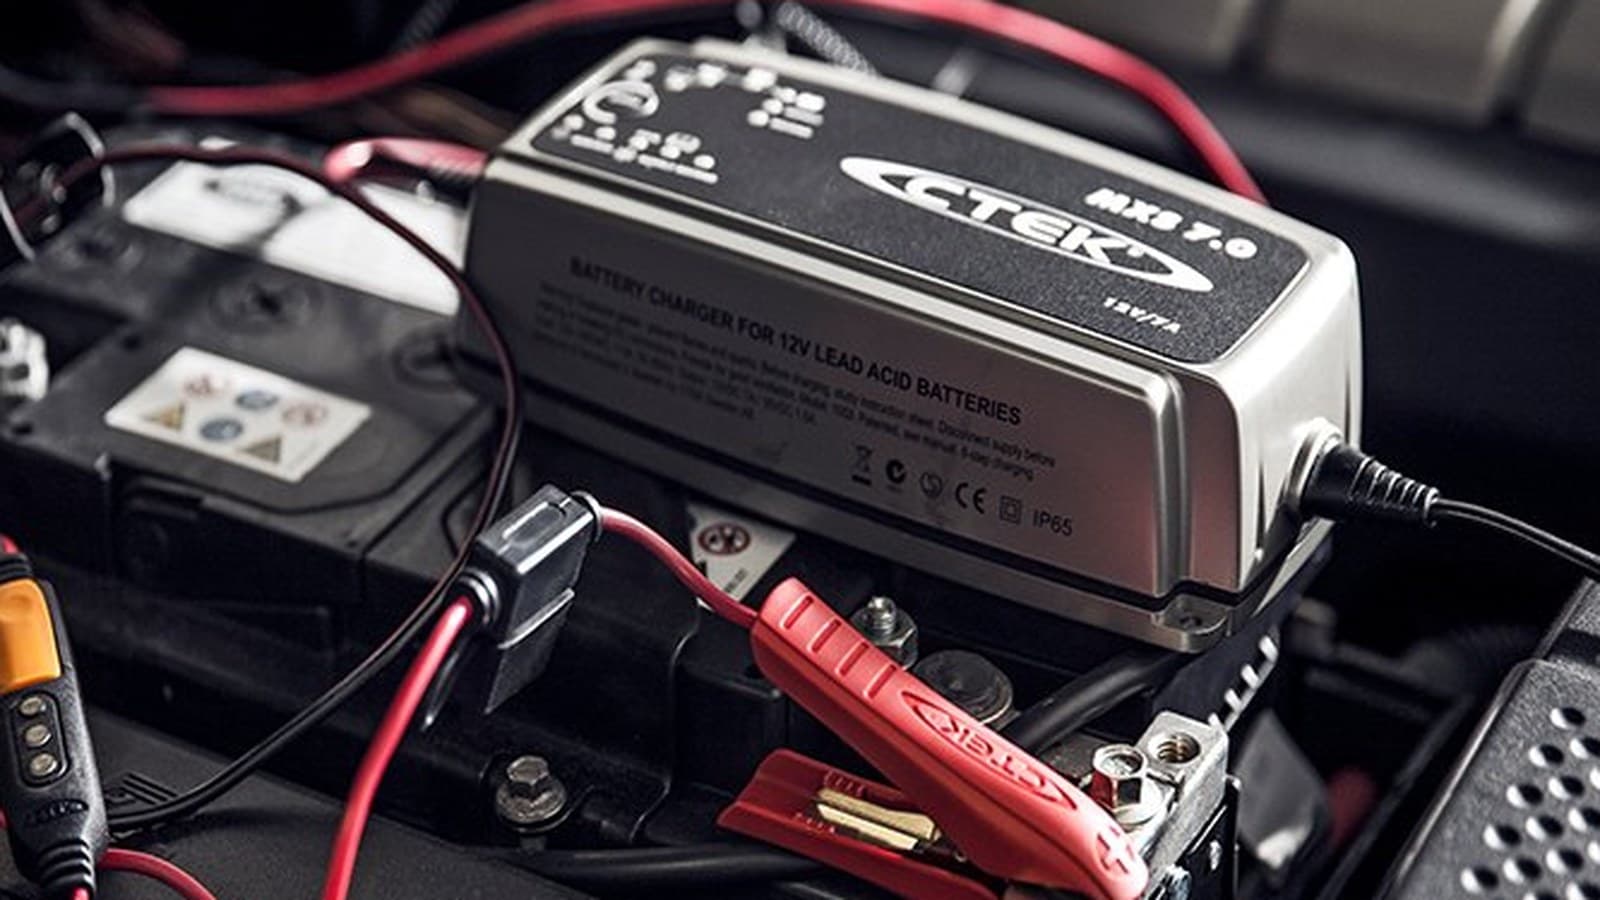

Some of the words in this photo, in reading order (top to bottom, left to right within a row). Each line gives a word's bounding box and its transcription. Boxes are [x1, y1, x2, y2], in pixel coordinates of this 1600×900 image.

[903, 174, 1128, 264] CTEK
[1085, 188, 1183, 232] MXS
[1183, 222, 1258, 259] 7.0
[570, 256, 648, 299] BATTERY
[650, 286, 734, 330] CHARGER
[737, 317, 775, 346] FOR
[779, 332, 811, 357] 12V
[815, 345, 865, 376] LEAD
[867, 363, 912, 391] ACID
[916, 377, 1022, 426] BATTERIES
[1103, 297, 1181, 333] 12V/7A
[1032, 508, 1073, 537] IP65
[941, 712, 1047, 789] CTEK
